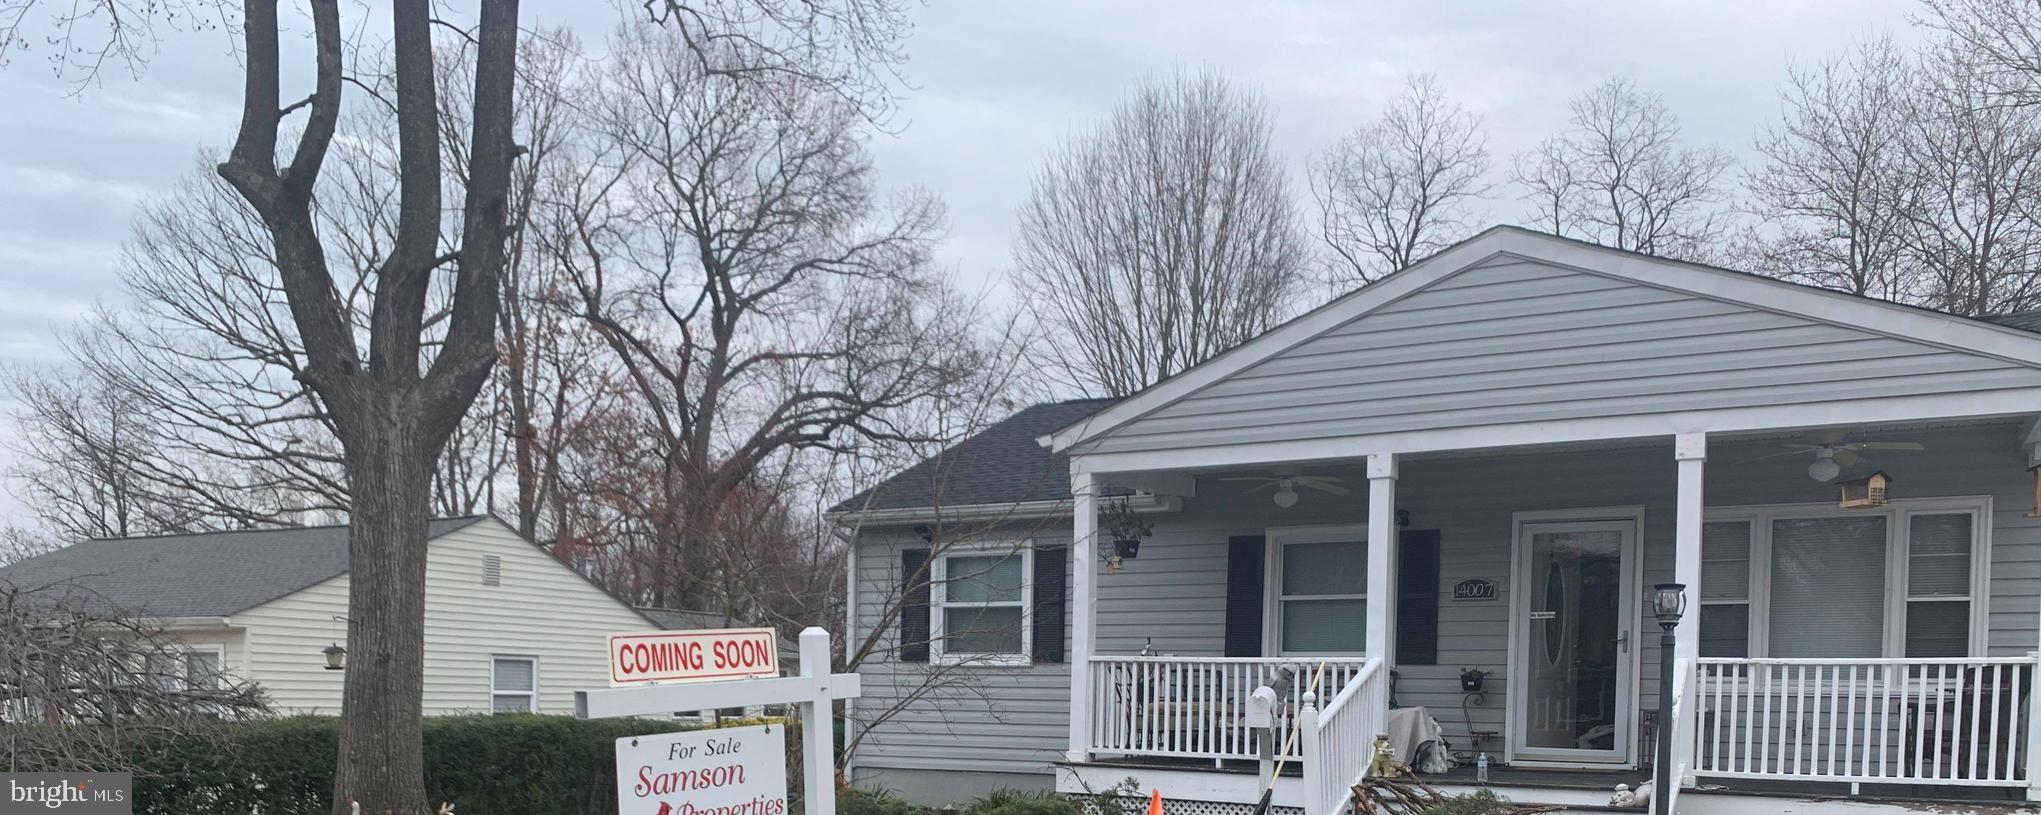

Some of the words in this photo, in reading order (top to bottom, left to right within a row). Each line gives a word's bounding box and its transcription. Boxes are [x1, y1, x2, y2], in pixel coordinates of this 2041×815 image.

[620, 641, 704, 674] COMING
[713, 640, 769, 668] SOON
[668, 742, 697, 760] For
[704, 737, 742, 757] Sale
[635, 764, 746, 798] Samson
